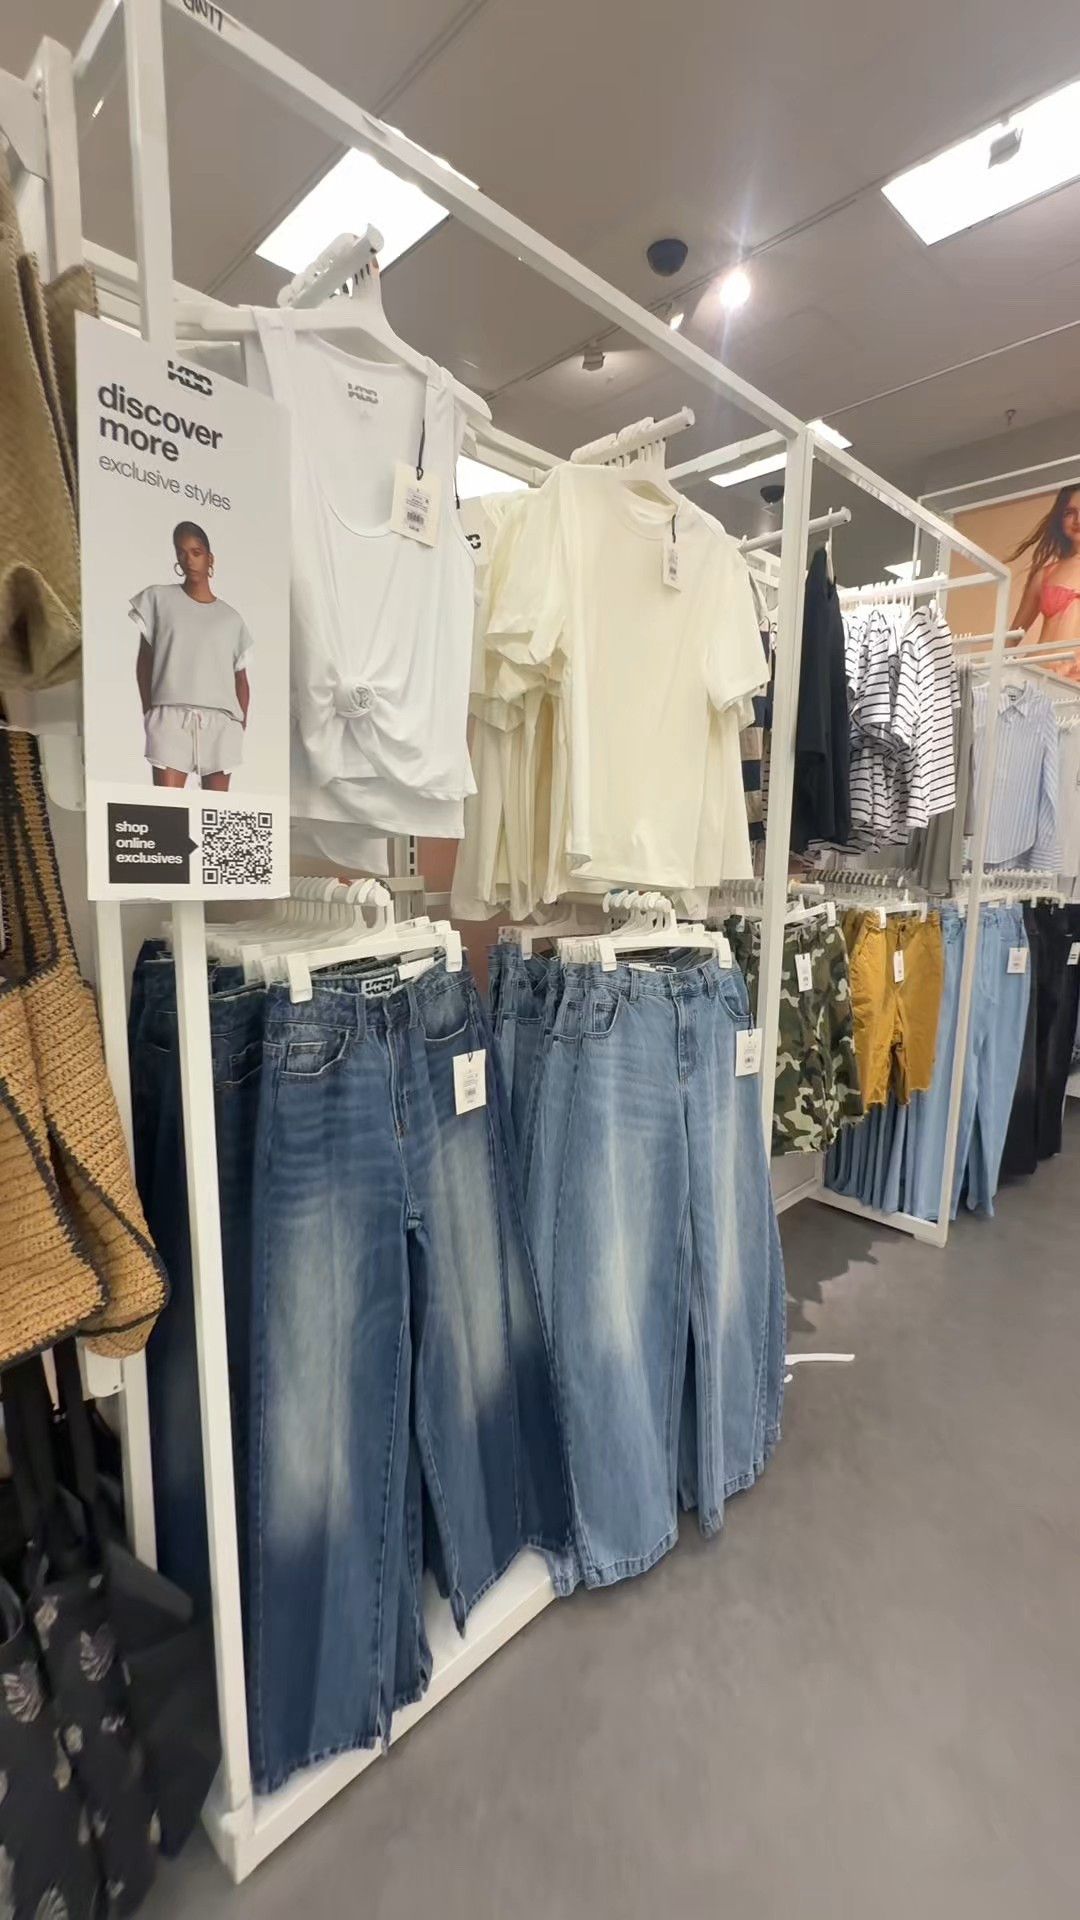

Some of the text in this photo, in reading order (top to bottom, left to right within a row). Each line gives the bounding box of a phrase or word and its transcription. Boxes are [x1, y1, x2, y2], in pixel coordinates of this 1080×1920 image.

[98, 383, 223, 449] discover
[100, 416, 179, 462] more
[99, 455, 231, 511] exclusive styles
[115, 821, 149, 835] shop
[116, 837, 156, 849] online
[116, 852, 183, 864] exclusives
